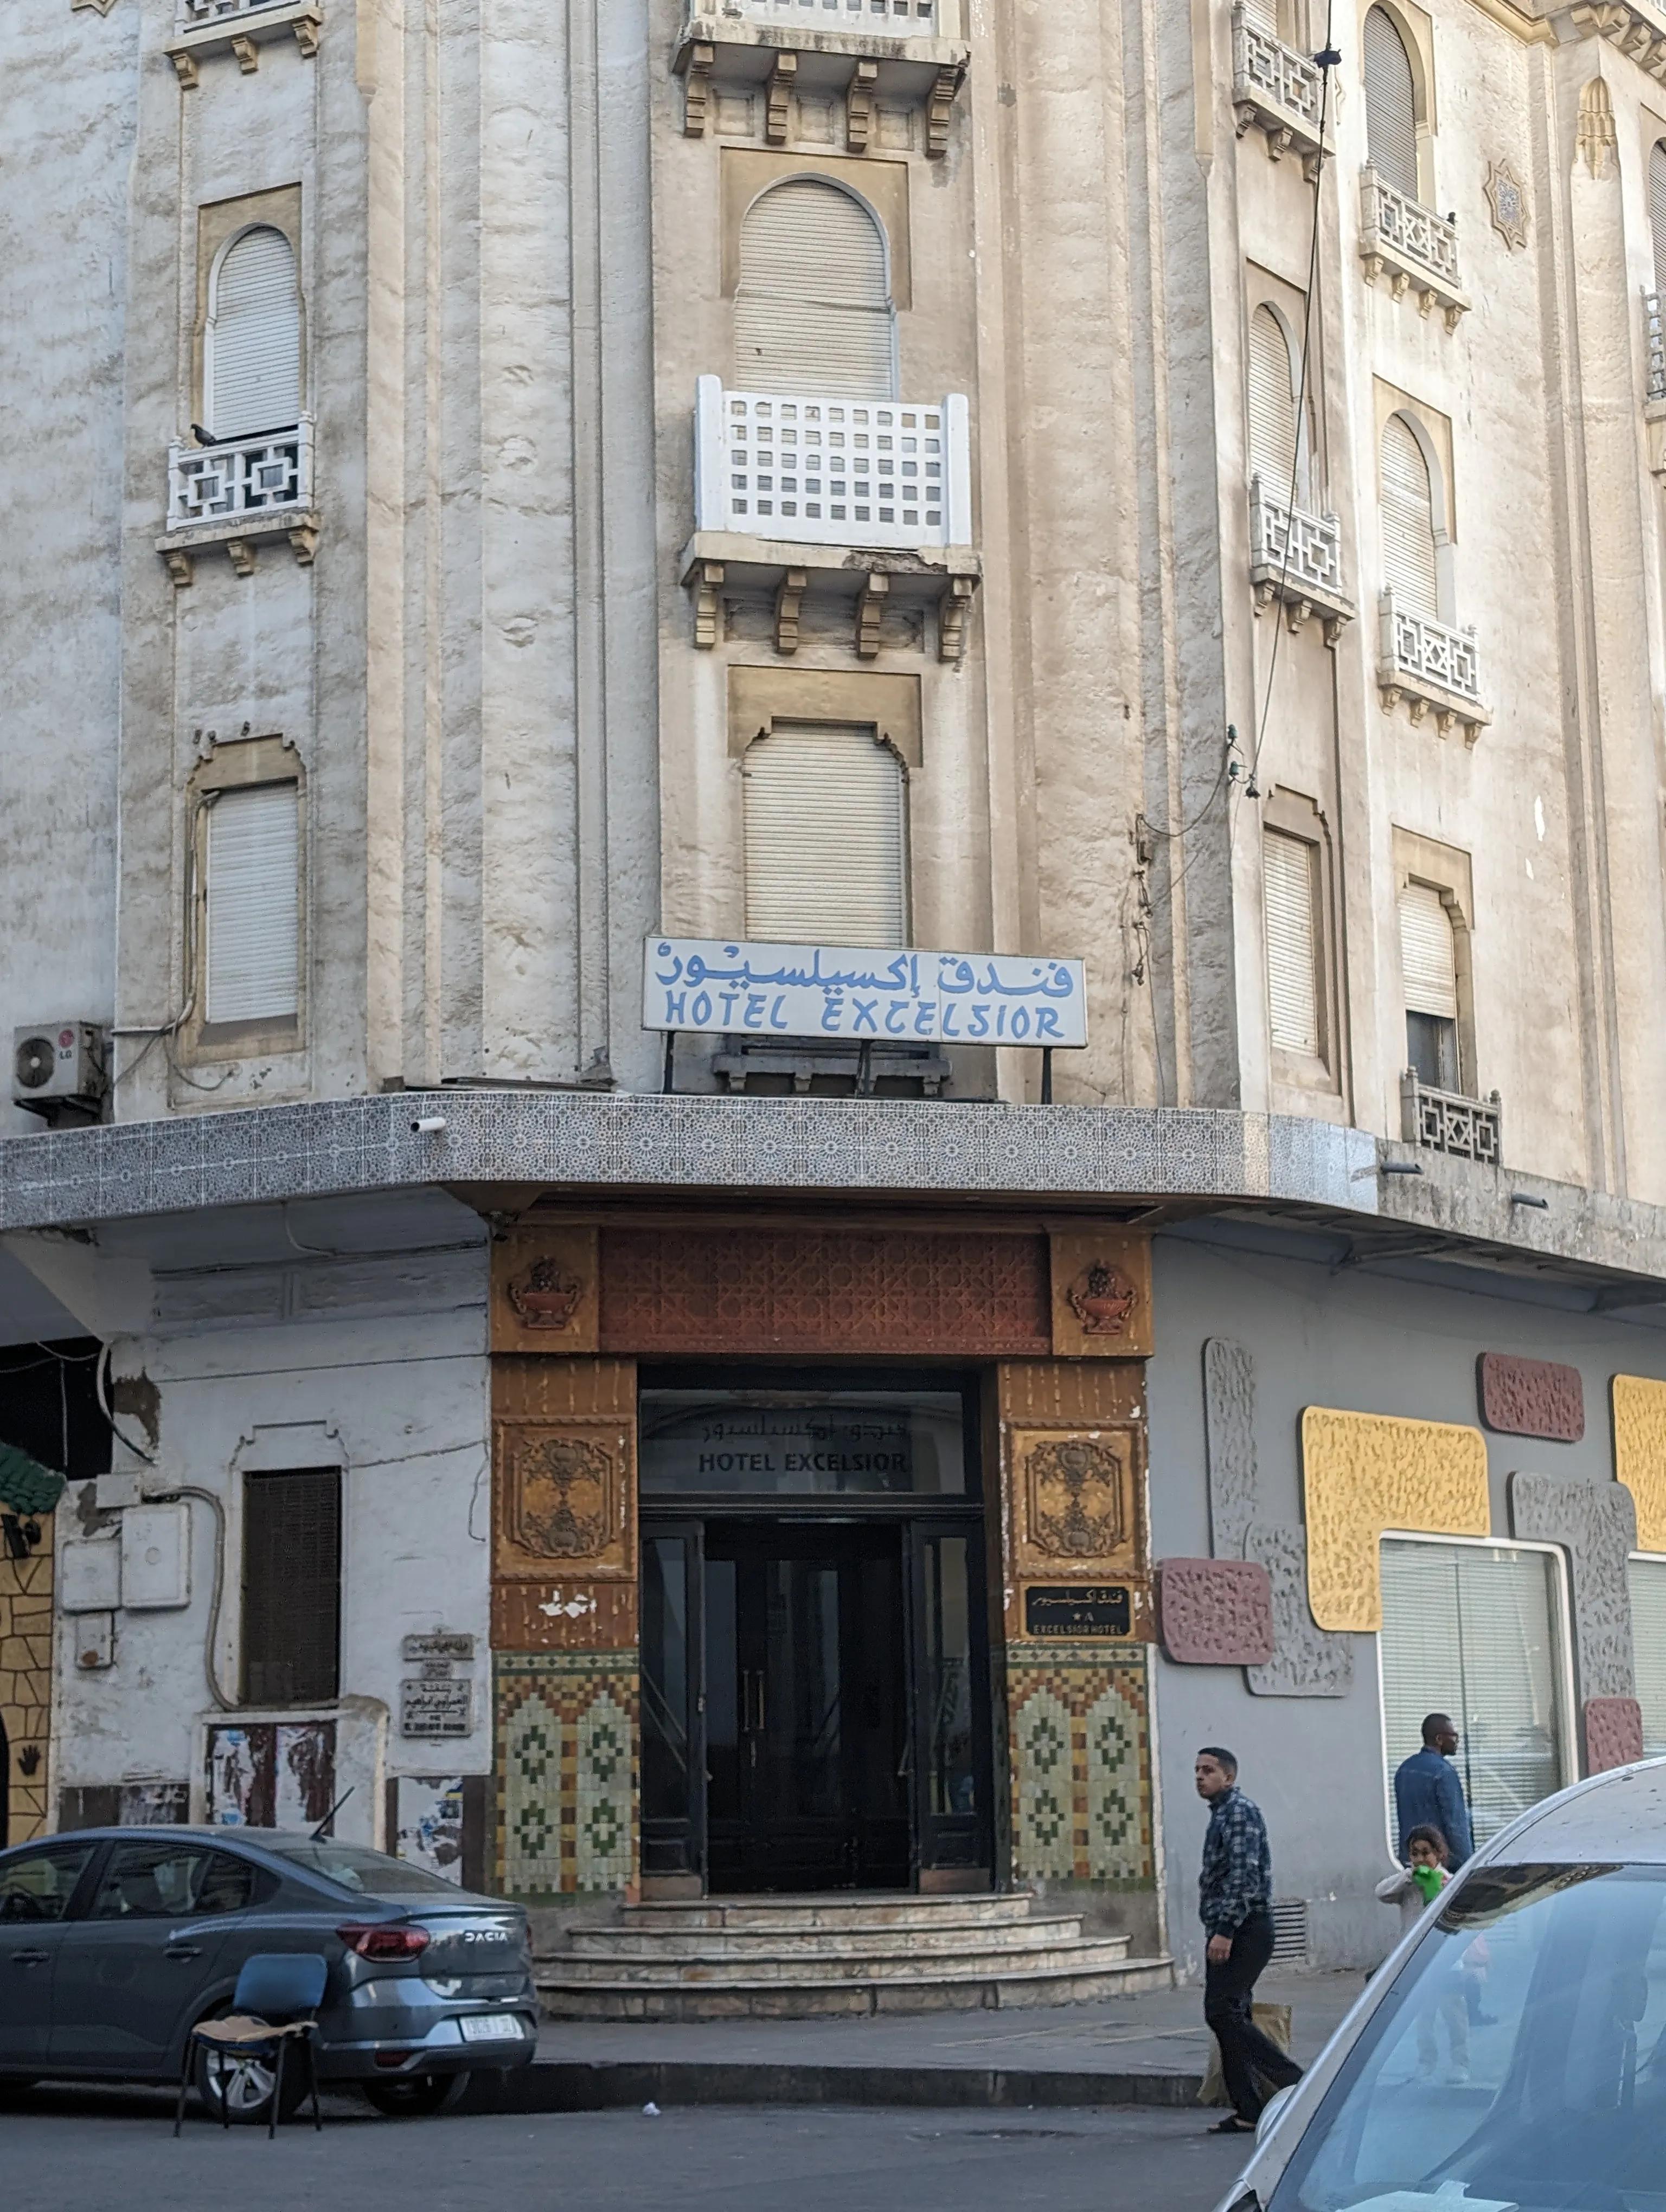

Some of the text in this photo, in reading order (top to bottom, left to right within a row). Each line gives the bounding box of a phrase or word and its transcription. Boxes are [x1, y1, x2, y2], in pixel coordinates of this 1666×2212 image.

[938, 956, 1074, 998] فندق
[665, 990, 1065, 1039] HOTEL EXCELSIOR
[59, 1051, 73, 1060] LG
[699, 1452, 912, 1473] HOTEL EXCELSIOR
[1085, 1612, 1094, 1622] A
[464, 1931, 508, 1943] DACIA
